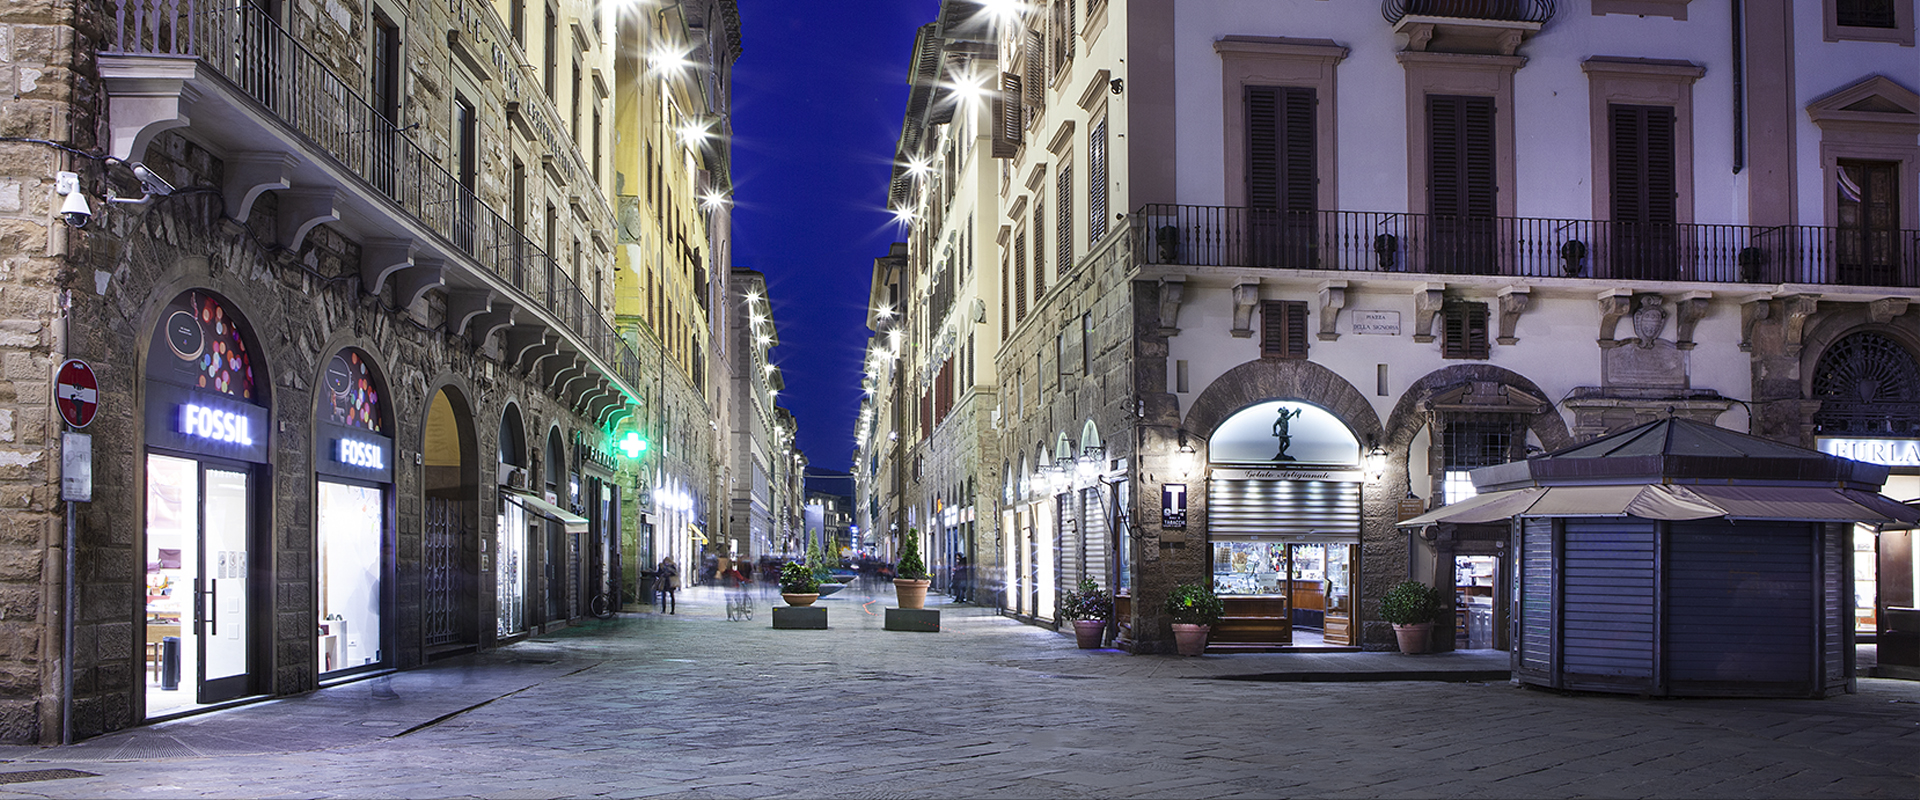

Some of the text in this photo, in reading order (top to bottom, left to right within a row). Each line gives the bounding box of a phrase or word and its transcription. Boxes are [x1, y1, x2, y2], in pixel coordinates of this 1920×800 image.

[185, 403, 252, 446] FOSSIL
[340, 438, 384, 470] FOSSIL
[1834, 442, 1920, 462] FURLA
[1277, 470, 1330, 479] Artigianale
[1166, 485, 1185, 515] T
